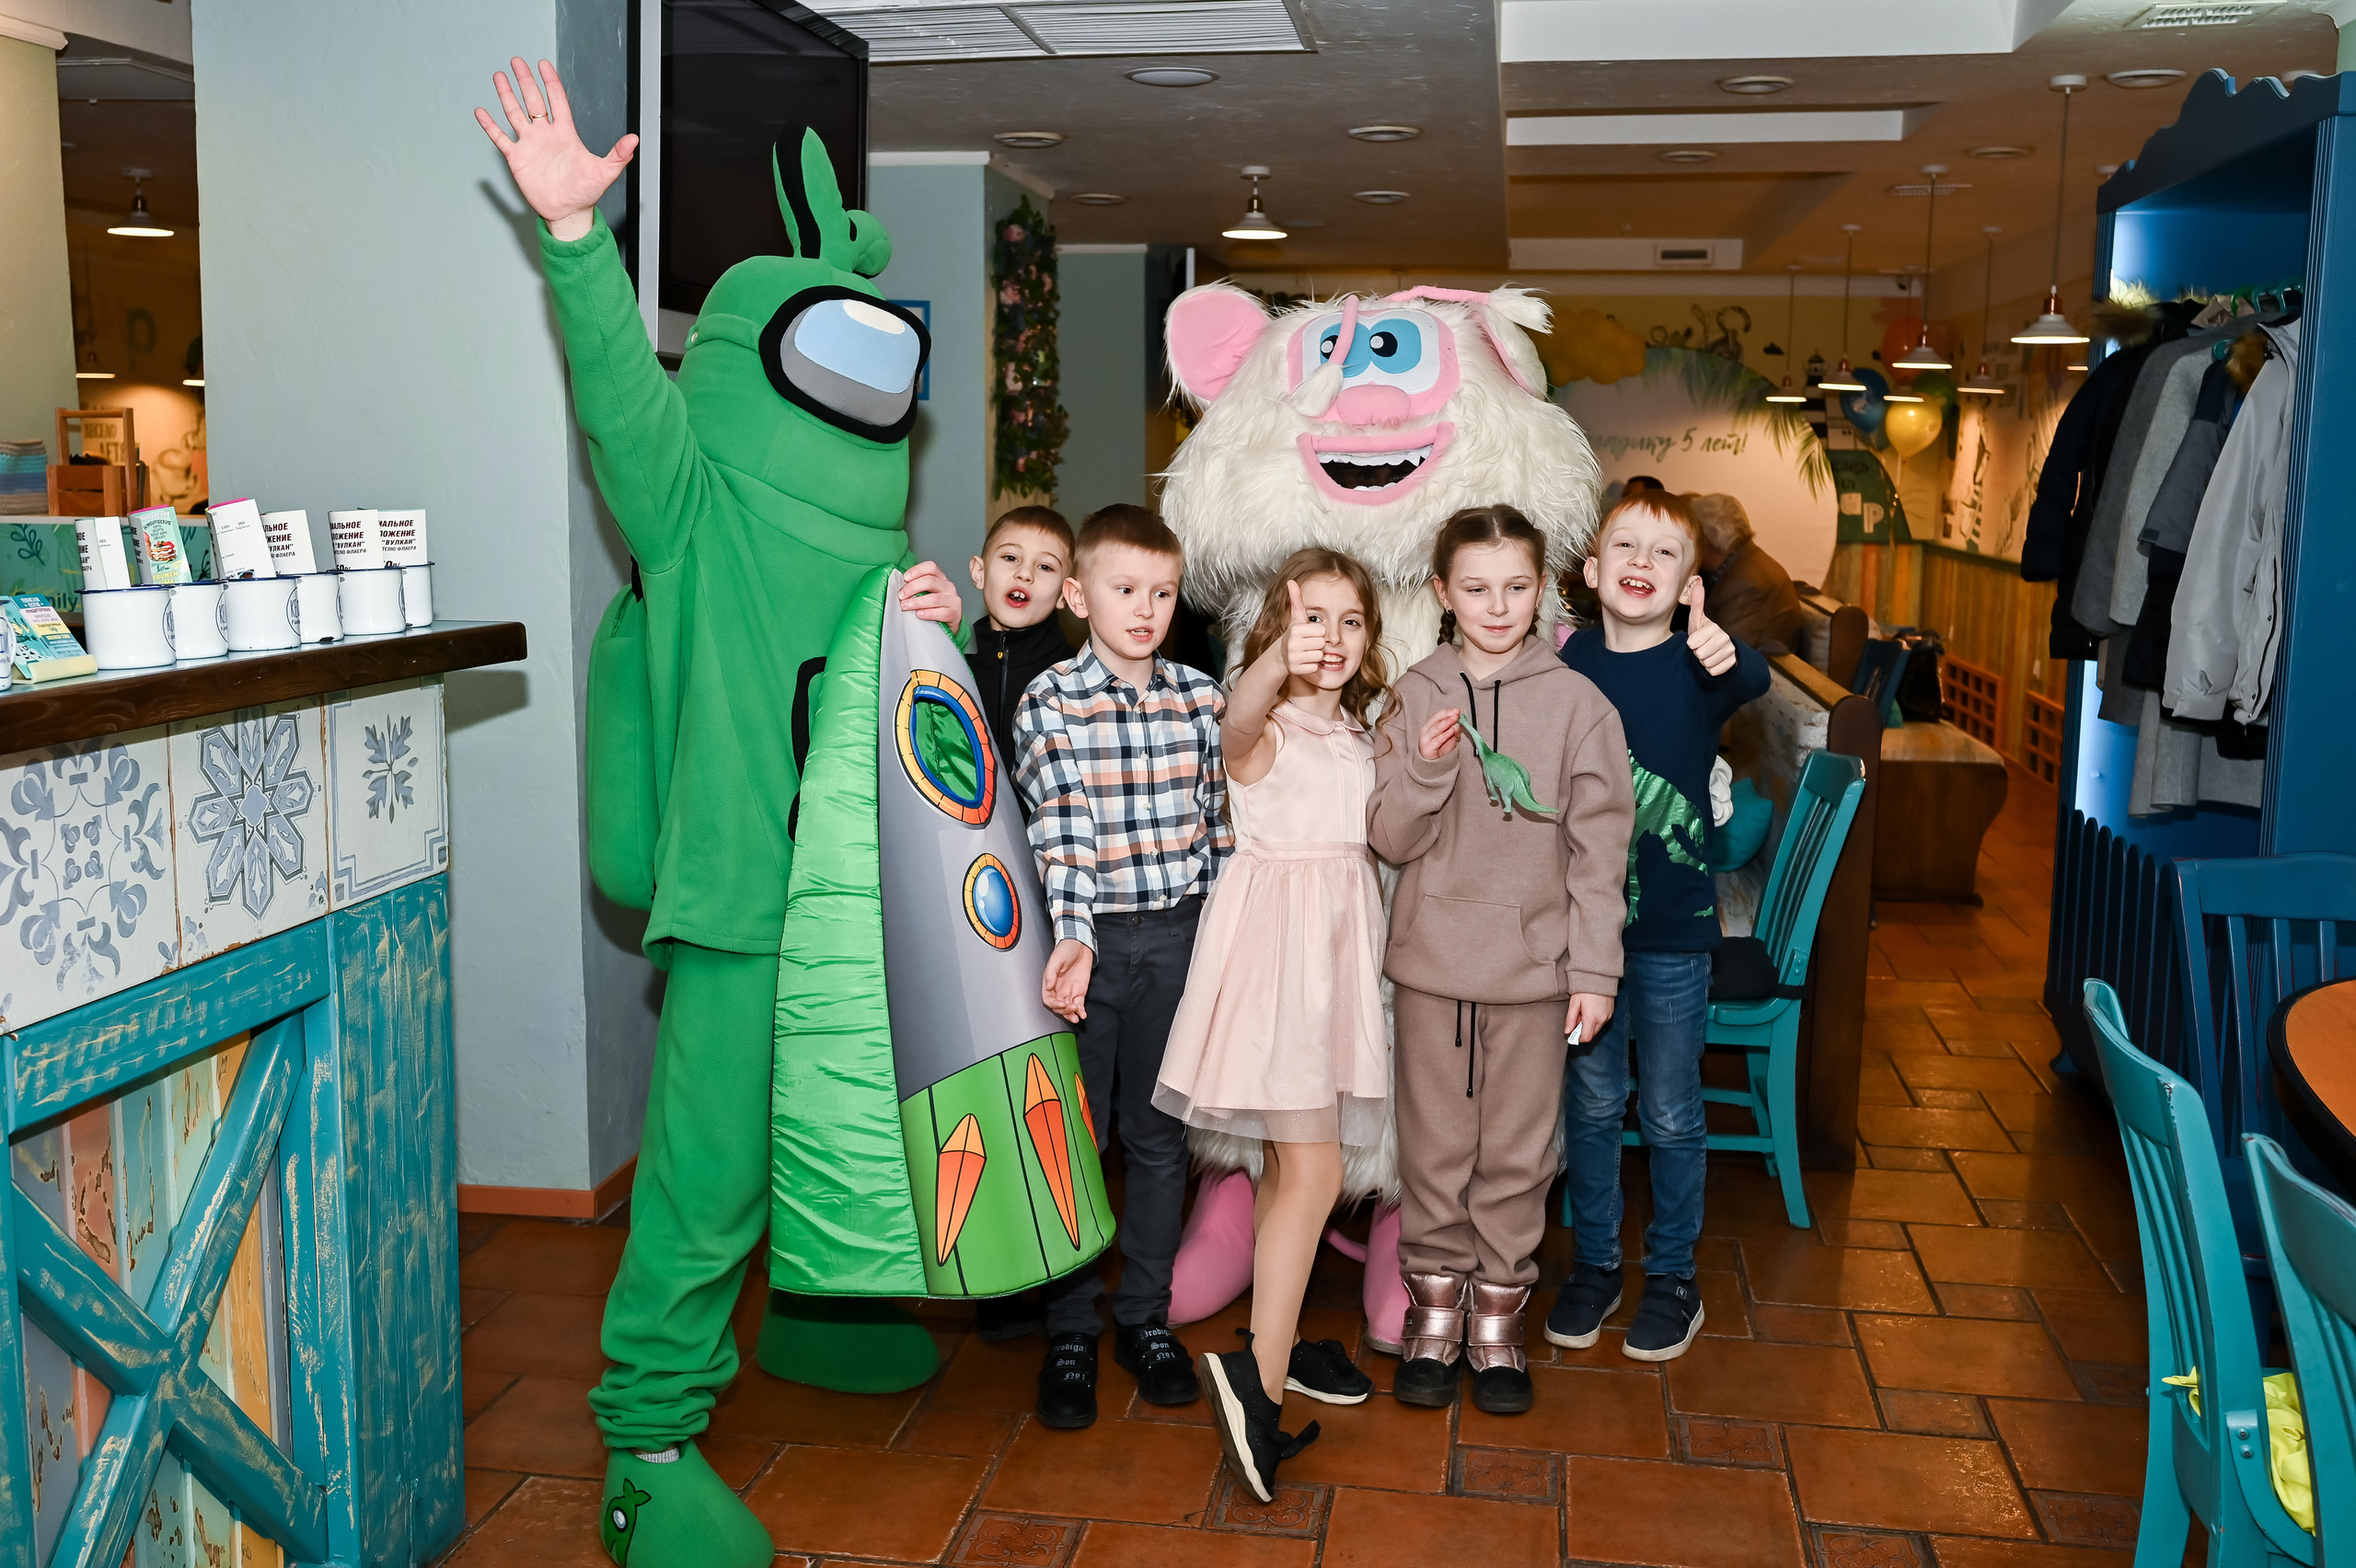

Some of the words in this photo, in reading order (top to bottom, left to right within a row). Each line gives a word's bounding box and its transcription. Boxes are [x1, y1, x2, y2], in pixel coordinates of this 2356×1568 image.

[1681, 427, 1698, 452] 5
[152, 571, 179, 582] BRUNCH
[1150, 1342, 1170, 1350] Son
[1056, 1358, 1076, 1366] Son
